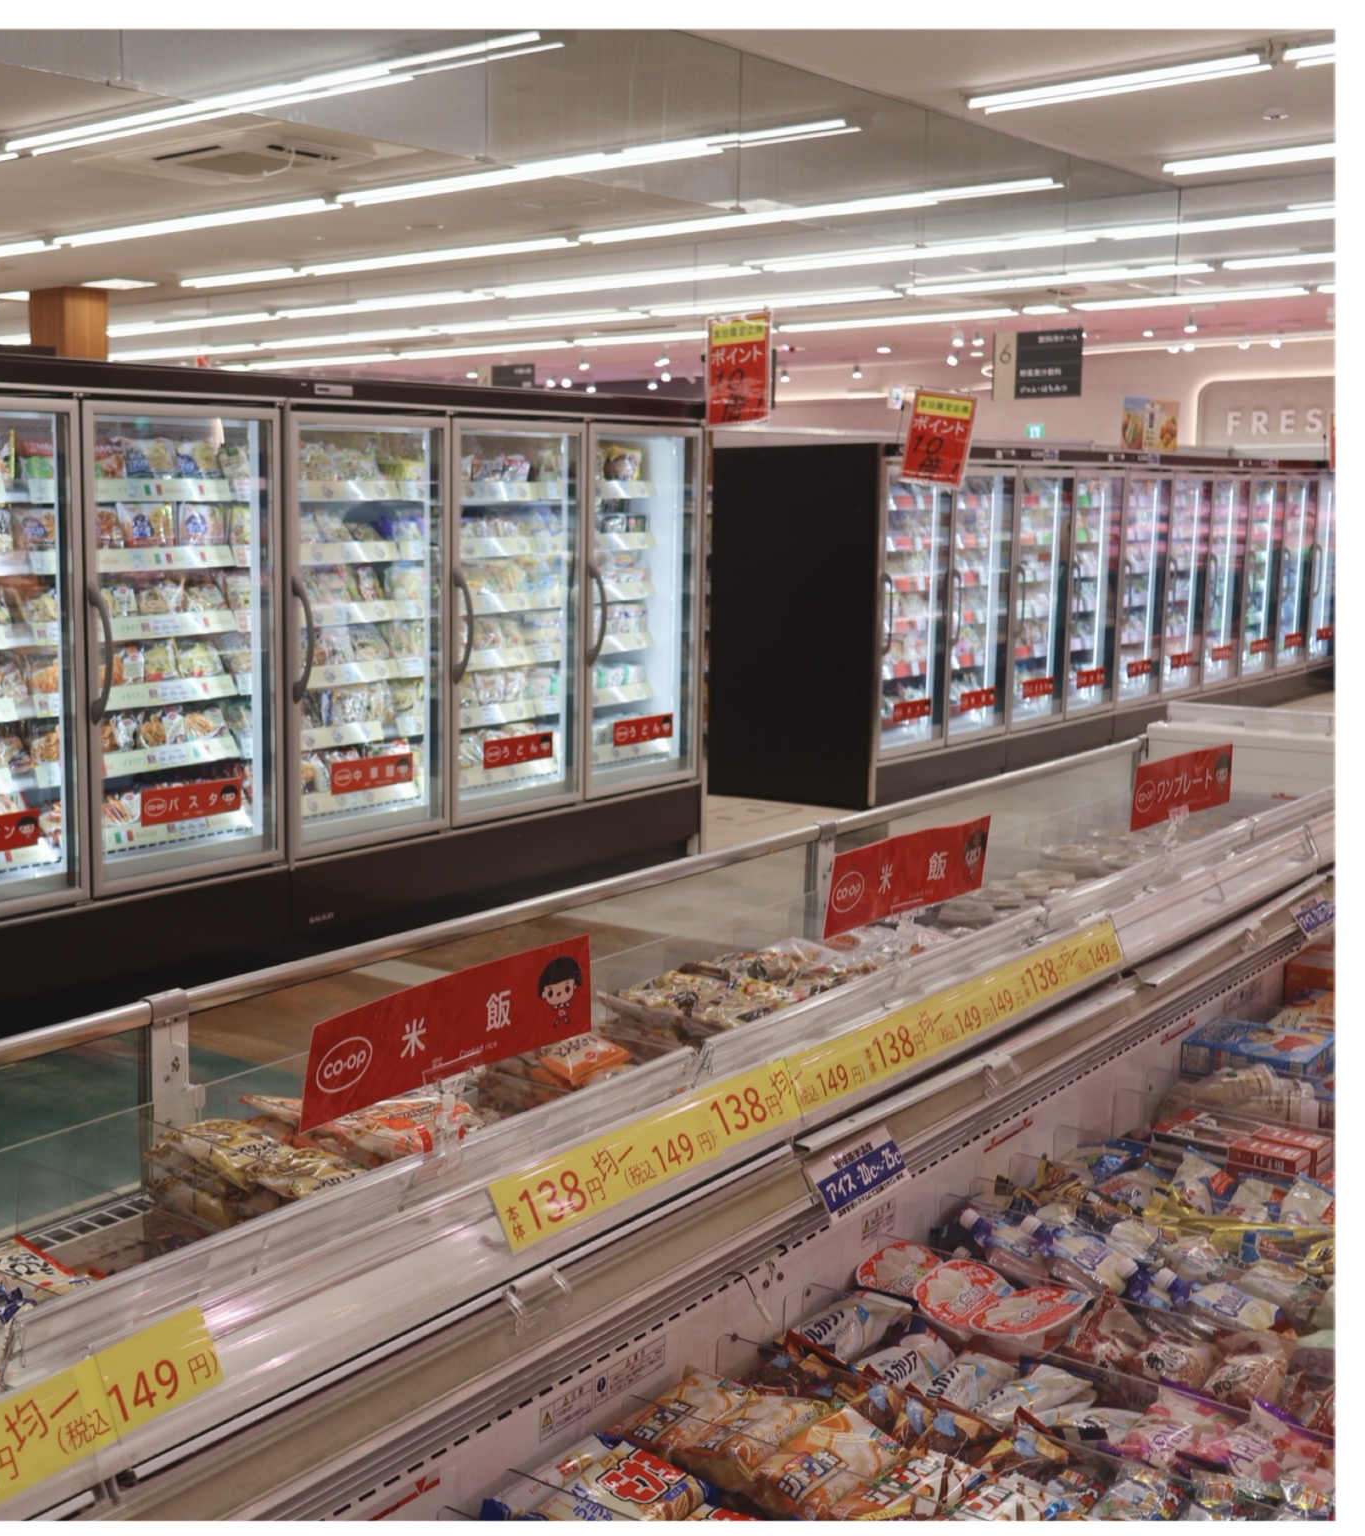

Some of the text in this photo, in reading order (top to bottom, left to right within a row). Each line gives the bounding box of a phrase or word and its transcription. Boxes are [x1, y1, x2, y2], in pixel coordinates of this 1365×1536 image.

[711, 346, 763, 366] ポイント
[998, 343, 1013, 365] 6
[913, 415, 965, 437] ポイント
[628, 723, 661, 739] うどん
[501, 741, 539, 759] うどん
[1155, 767, 1215, 804] ワンプレート
[168, 792, 219, 812] パスタ
[400, 991, 512, 1059] 米飯
[826, 1173, 857, 1203] アイス
